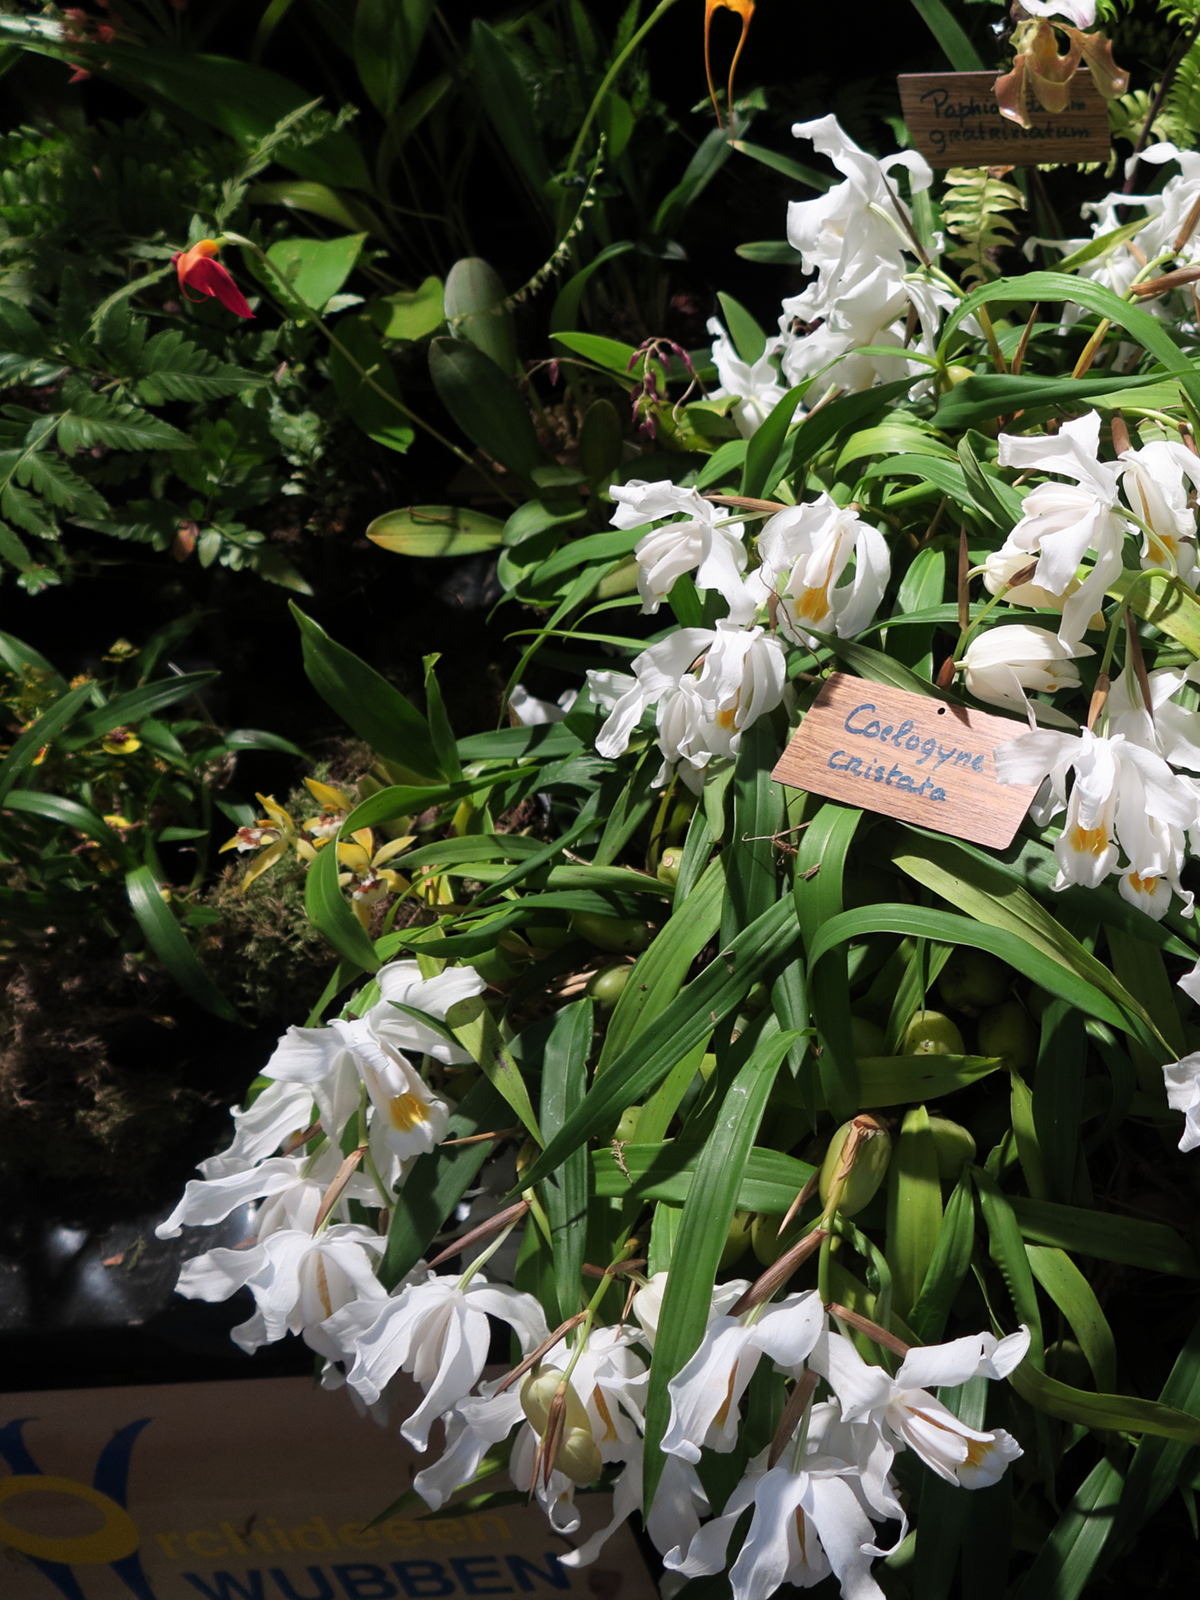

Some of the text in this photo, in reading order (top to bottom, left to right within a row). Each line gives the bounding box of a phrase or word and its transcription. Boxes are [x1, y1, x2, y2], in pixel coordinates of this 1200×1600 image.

[843, 703, 986, 774] Coelogyne
[826, 750, 947, 803] cristata
[182, 1552, 573, 1600] WUBBEN
